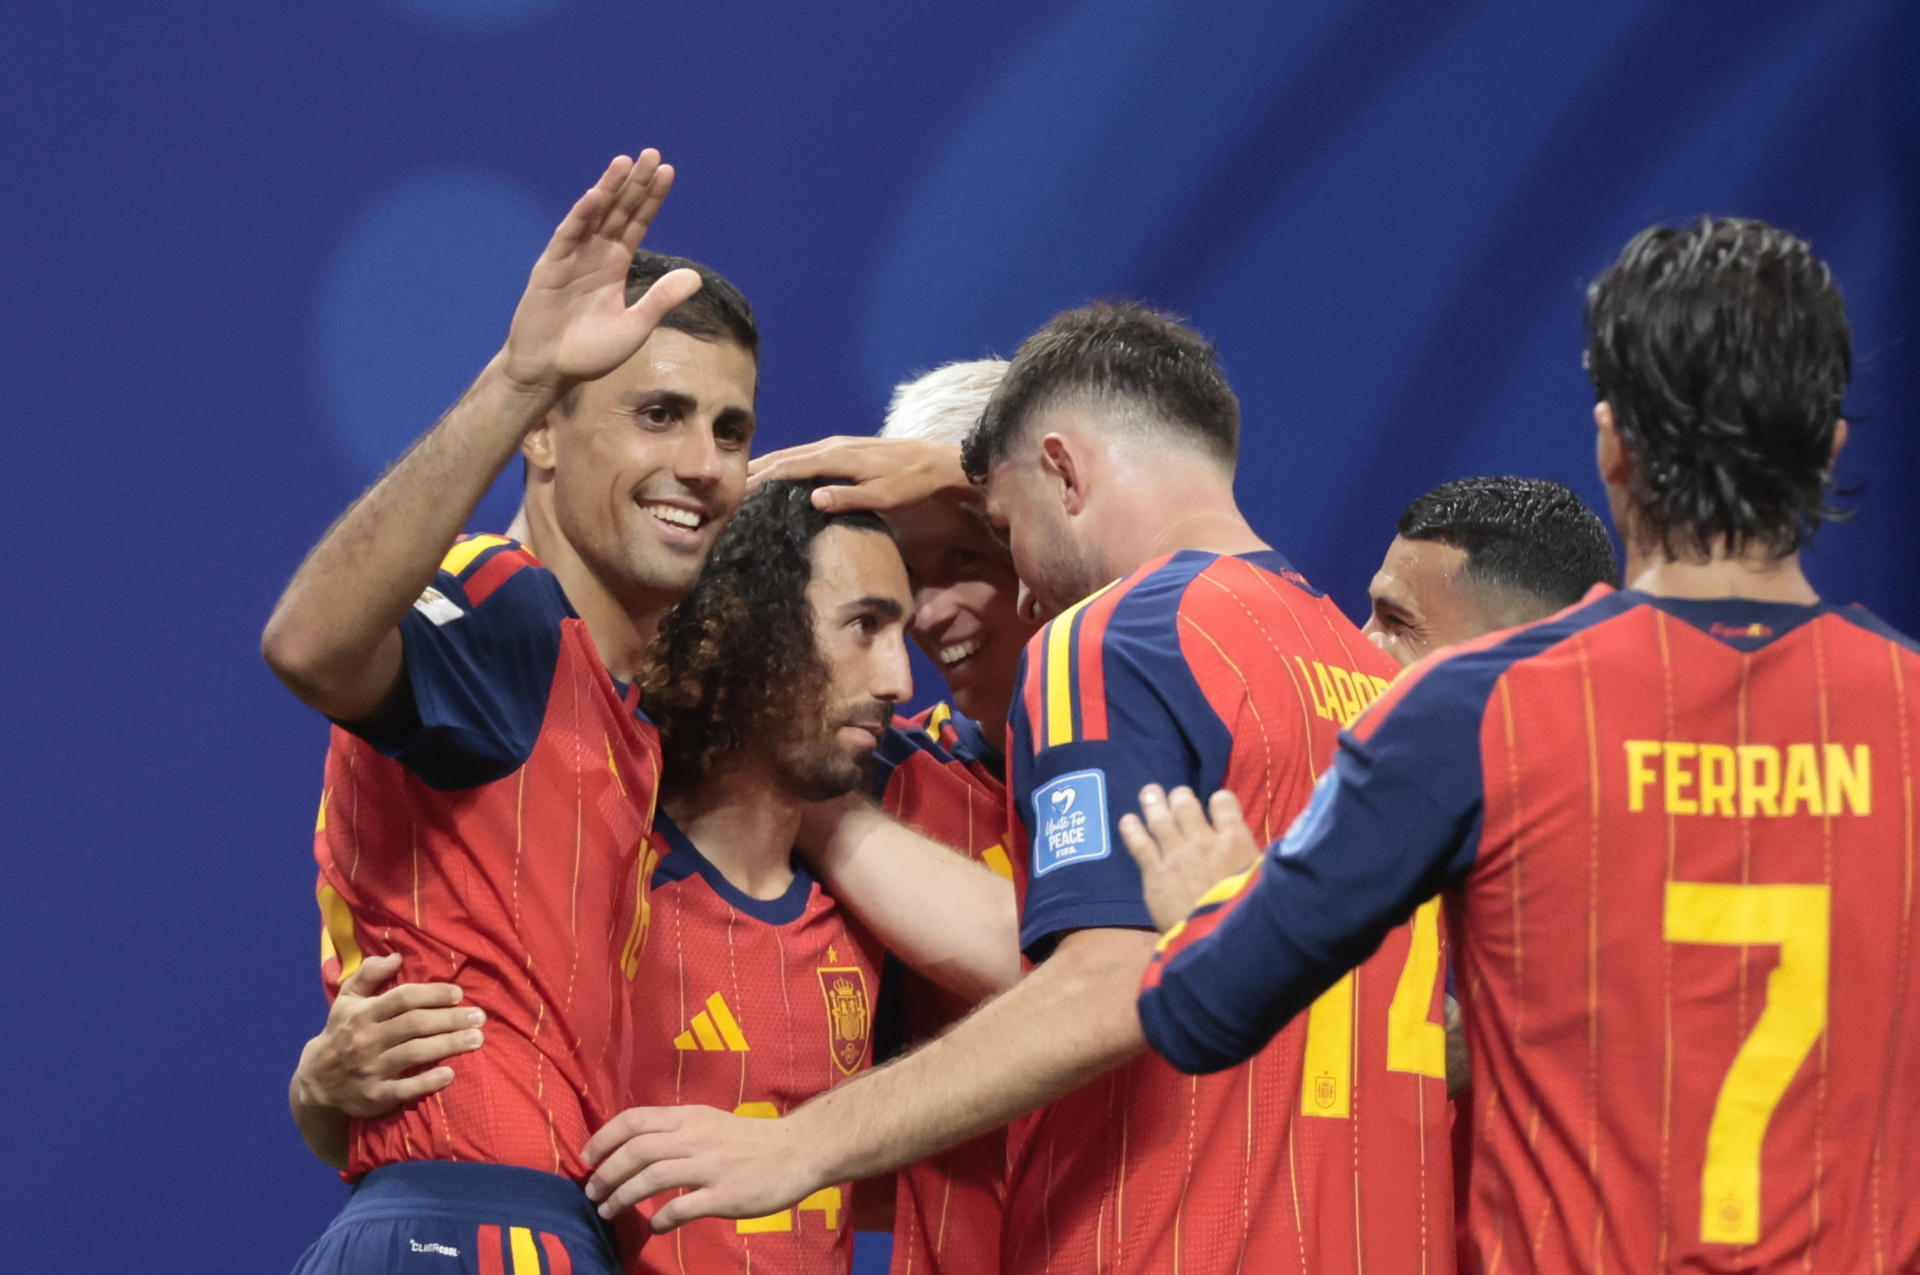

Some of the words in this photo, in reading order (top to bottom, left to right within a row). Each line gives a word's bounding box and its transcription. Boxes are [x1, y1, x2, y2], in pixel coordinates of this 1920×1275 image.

[1624, 740, 1871, 817] FERRAN
[1048, 827, 1086, 852] PEACE
[1055, 845, 1077, 858] FIFA
[1663, 880, 1831, 1245] 7
